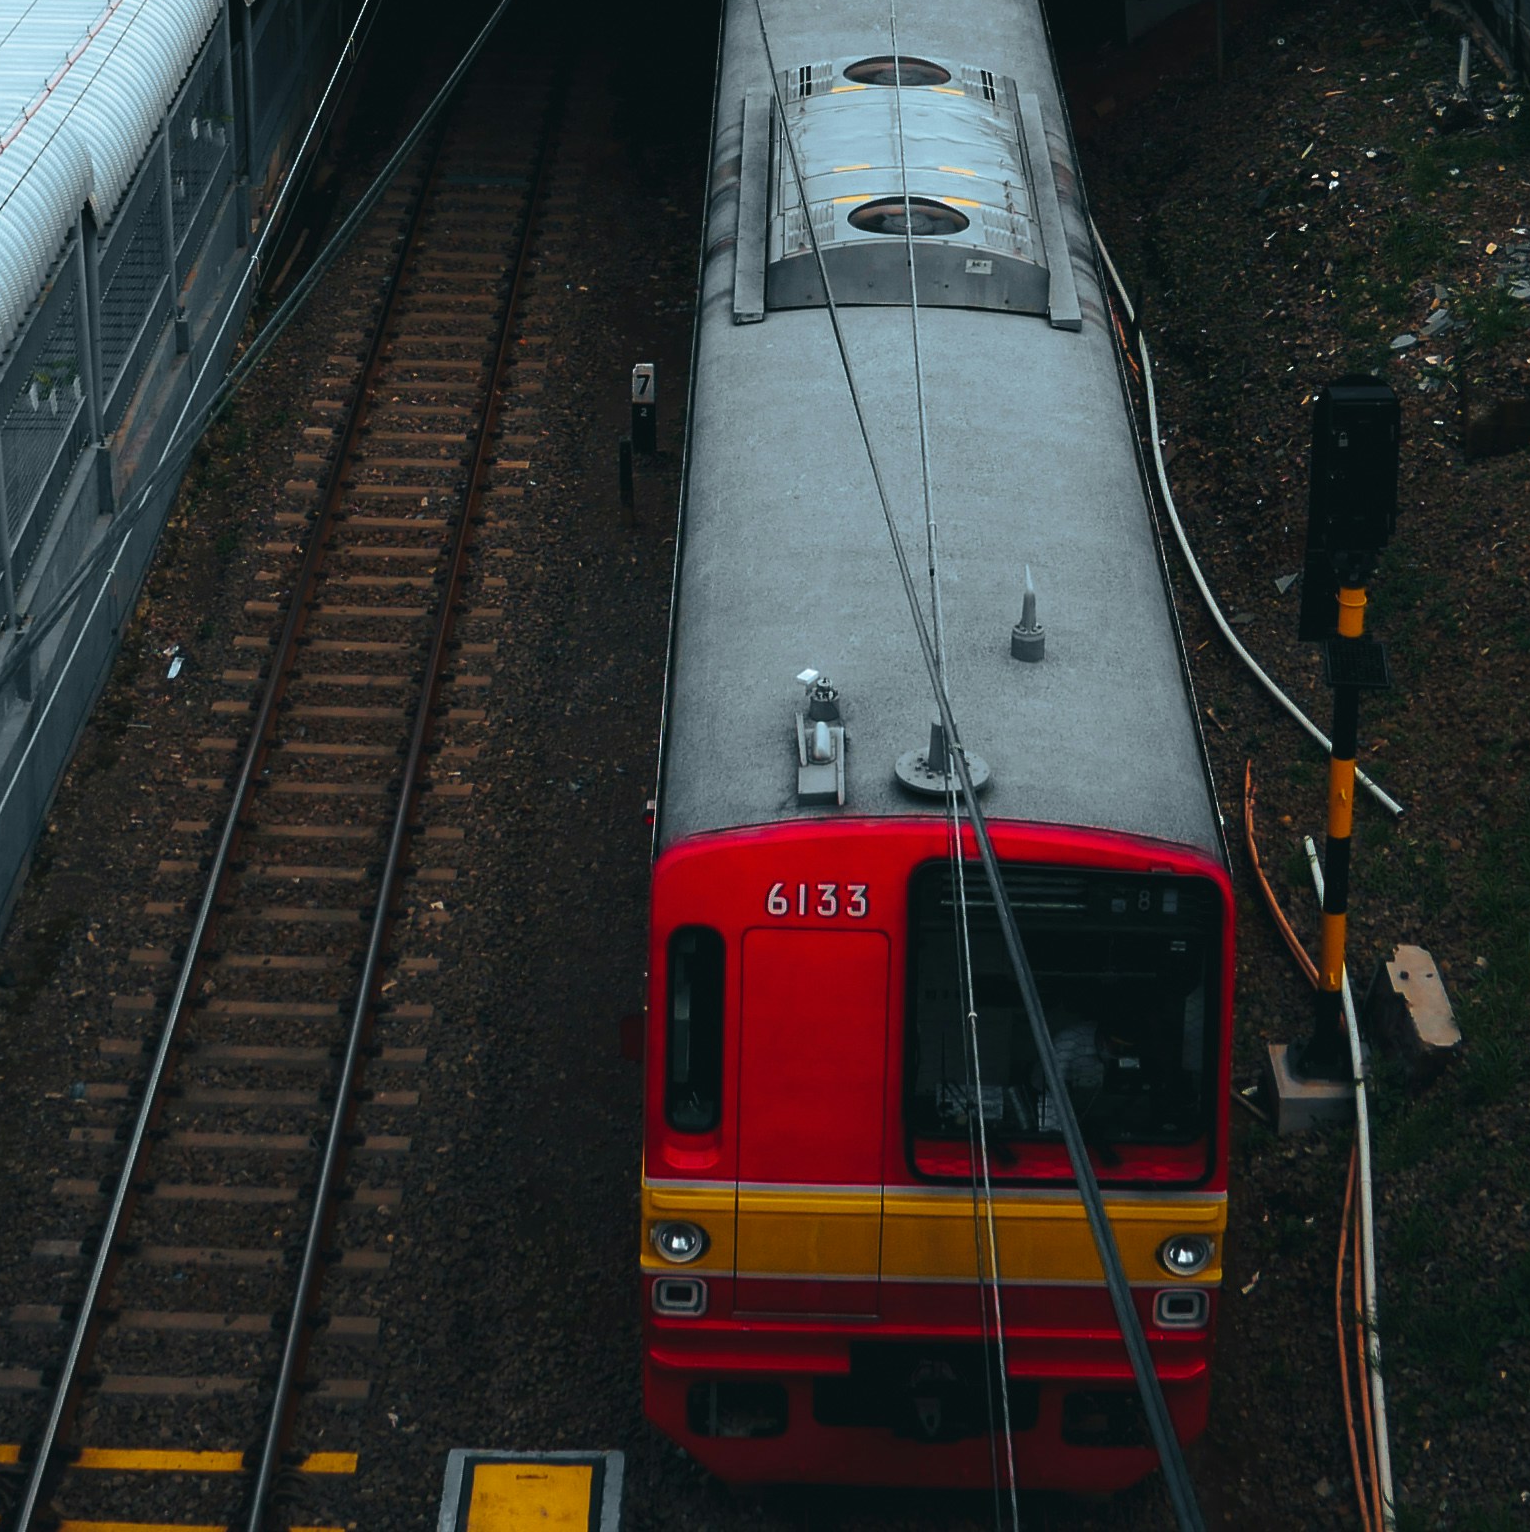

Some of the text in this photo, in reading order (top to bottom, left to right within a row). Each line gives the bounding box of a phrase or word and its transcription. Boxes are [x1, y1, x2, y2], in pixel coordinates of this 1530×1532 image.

[636, 374, 651, 396] 7
[640, 407, 648, 418] 2
[767, 881, 869, 919] 6133
[1137, 889, 1151, 912] 8
